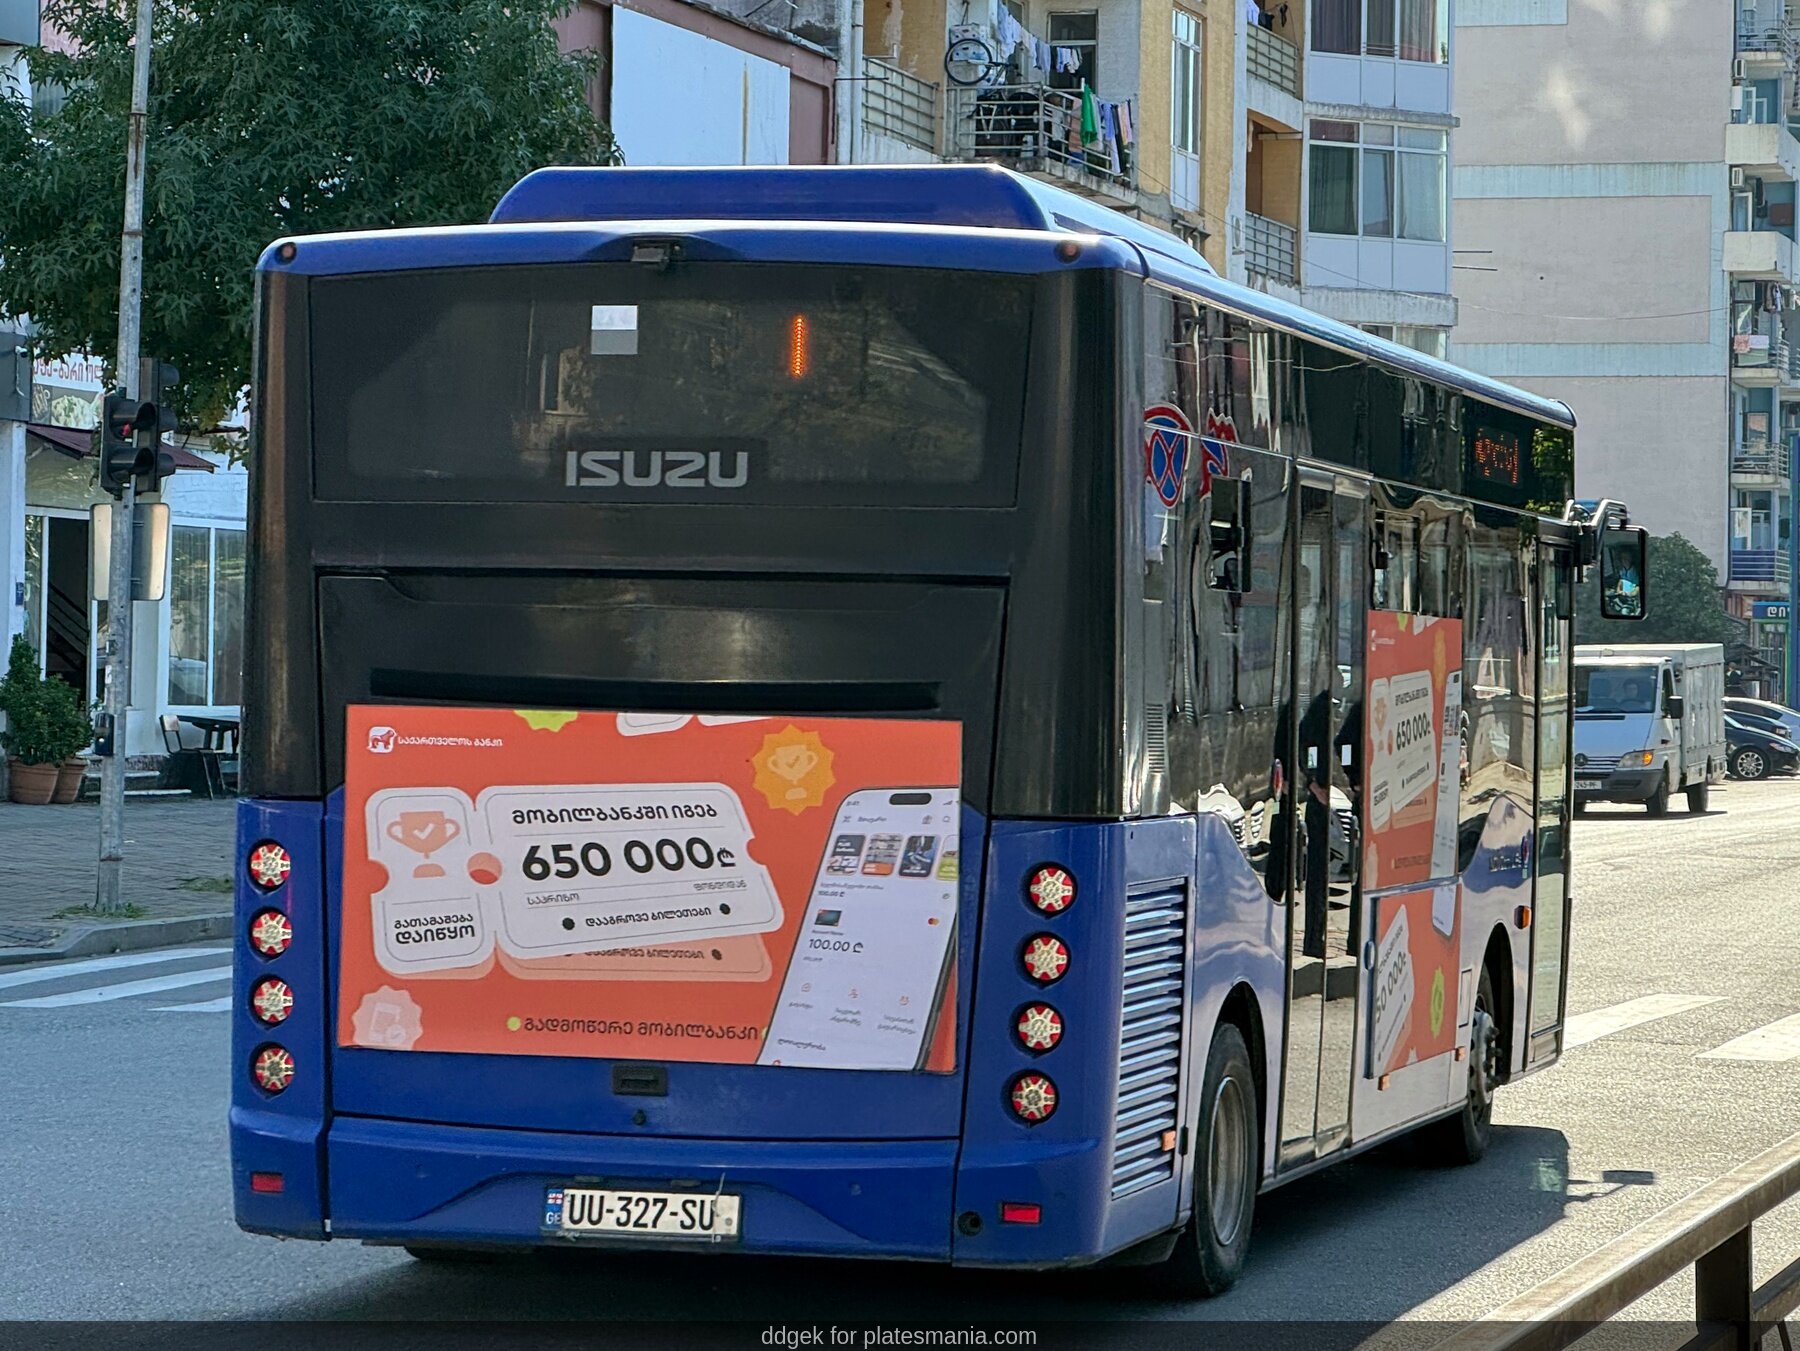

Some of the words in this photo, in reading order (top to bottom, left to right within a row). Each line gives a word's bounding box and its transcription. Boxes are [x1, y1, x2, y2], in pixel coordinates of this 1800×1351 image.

[565, 450, 749, 488] ISUZU
[1767, 606, 1790, 618] დი
[474, 737, 503, 747] ბანკი
[512, 805, 669, 825] მობილბანკში
[673, 803, 718, 820] იგებ
[522, 841, 612, 881] 650
[394, 913, 474, 930] გათამაშება
[585, 912, 650, 928] დააგროვე
[395, 924, 476, 945] დაიწყო
[808, 938, 850, 953] 100.00
[523, 1017, 635, 1036] გადმოწერე
[637, 1021, 759, 1041] მობილბანკი
[568, 1193, 716, 1231] UU-327-SU
